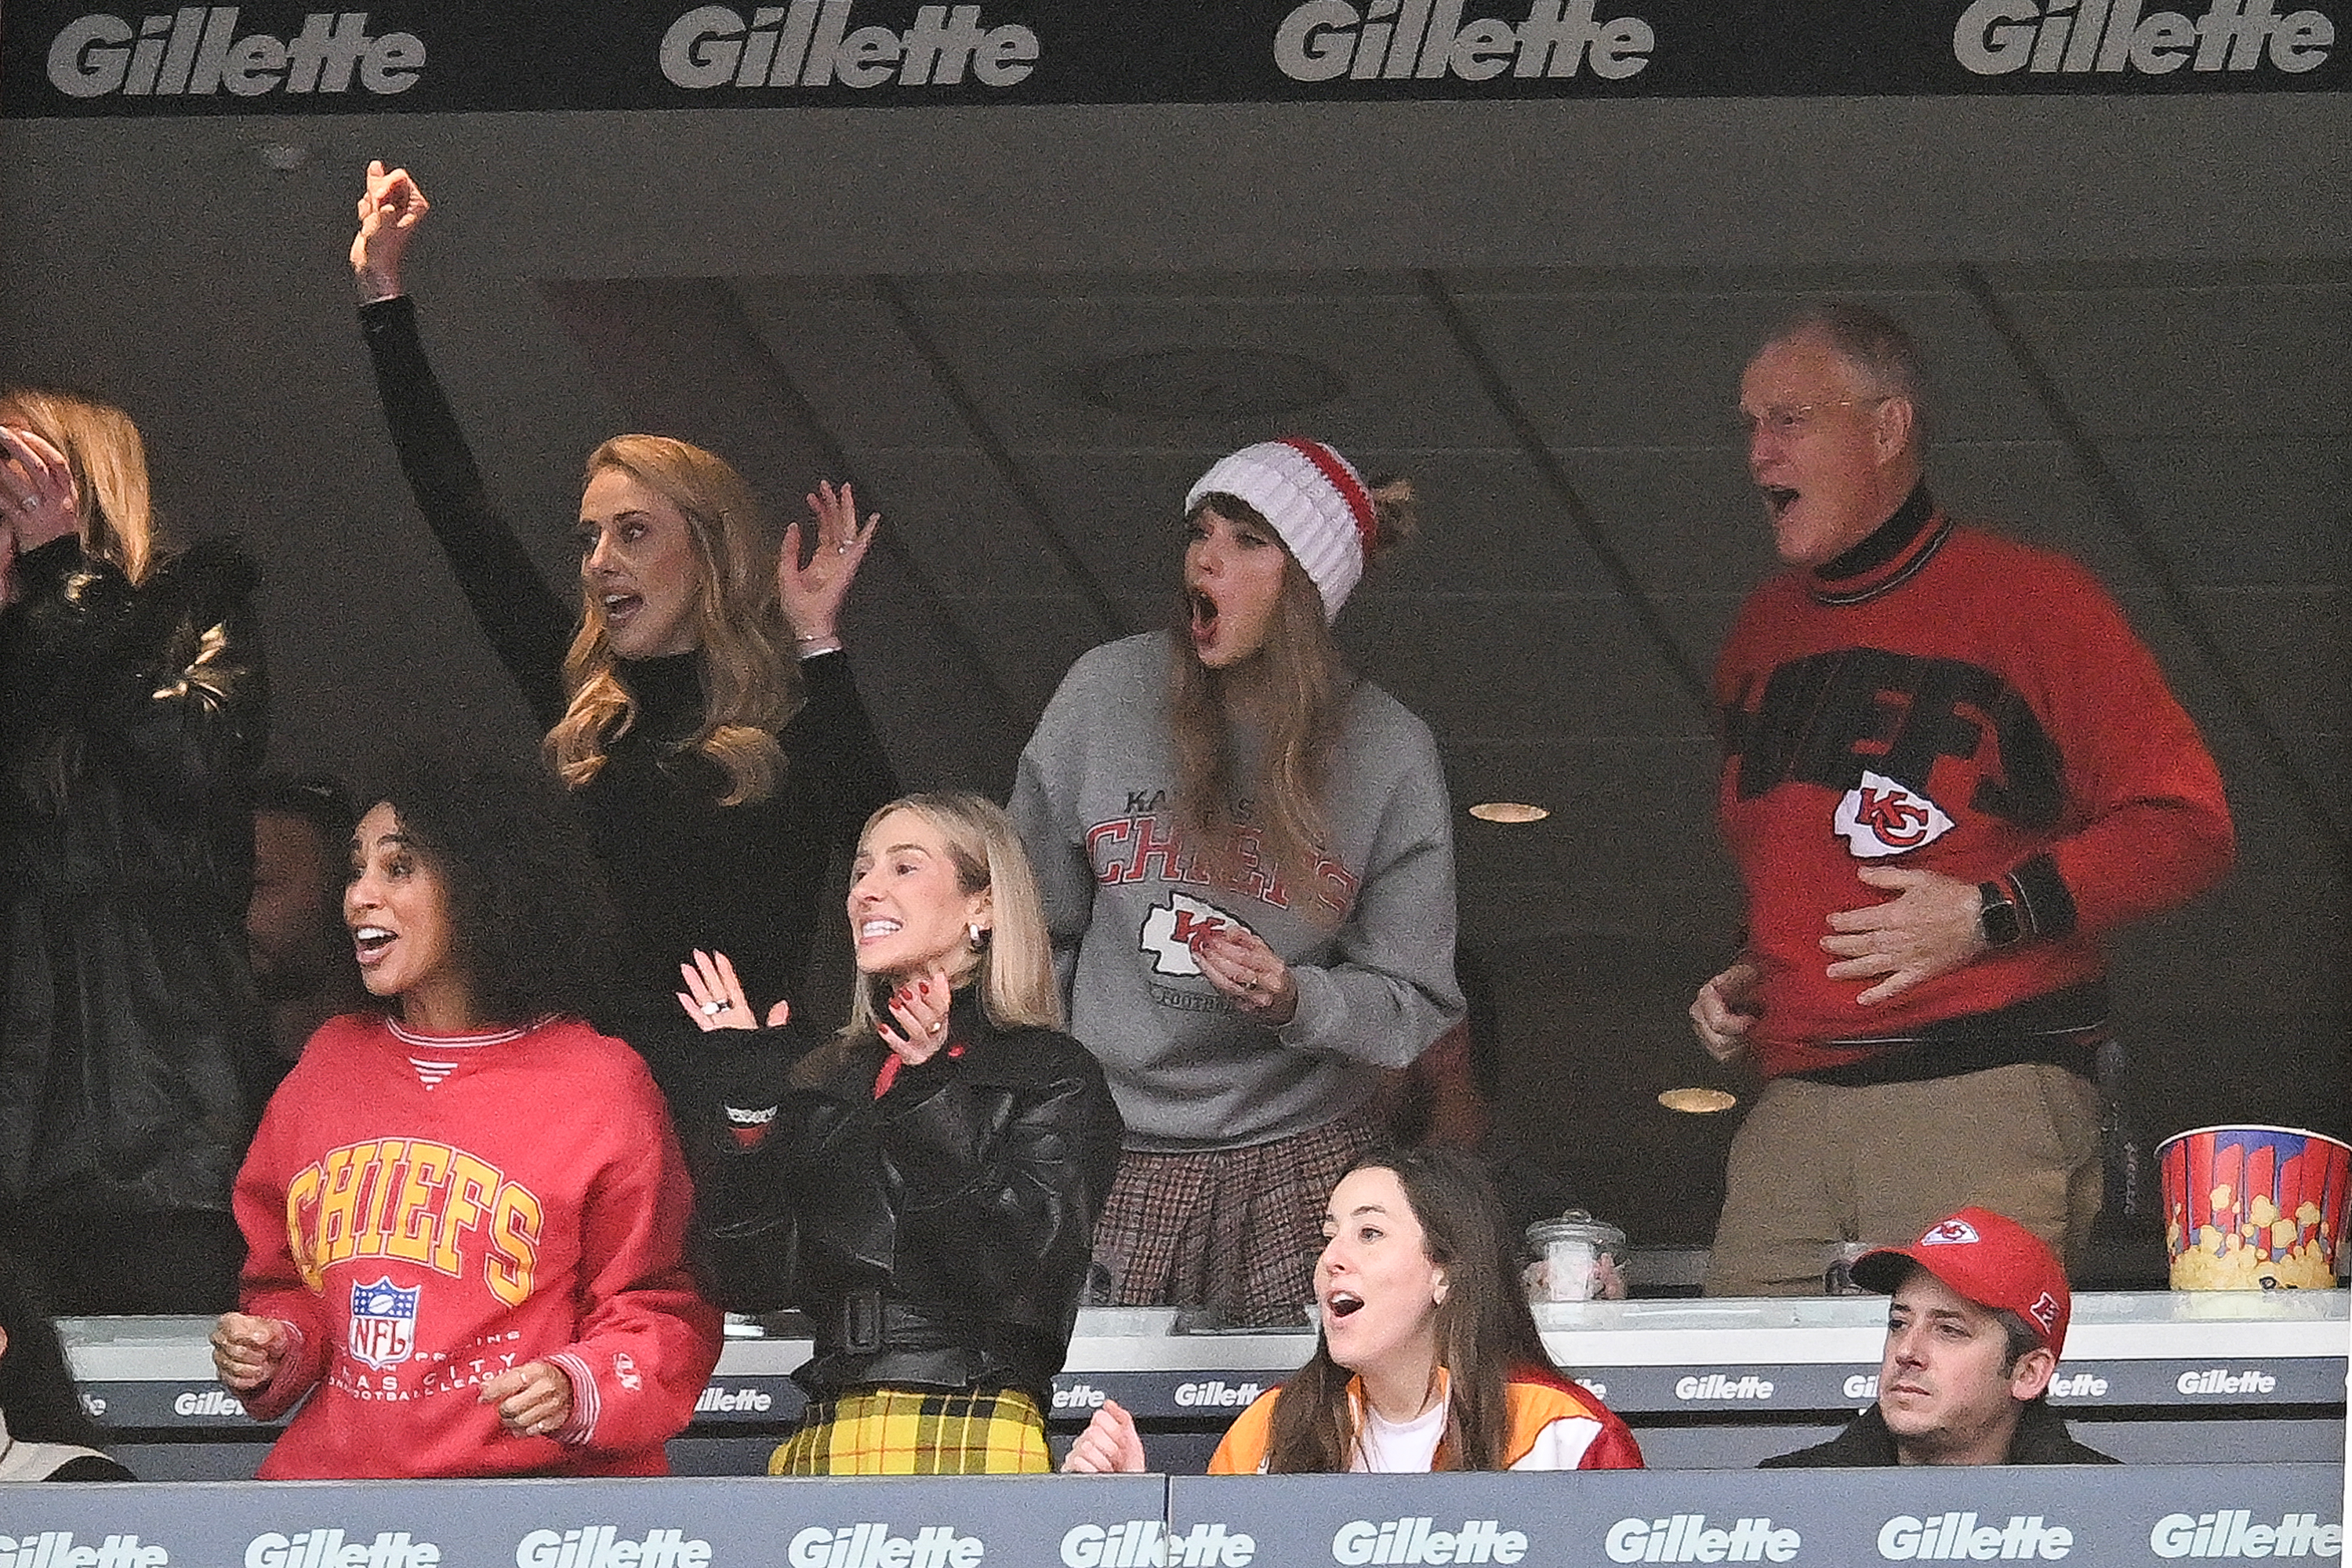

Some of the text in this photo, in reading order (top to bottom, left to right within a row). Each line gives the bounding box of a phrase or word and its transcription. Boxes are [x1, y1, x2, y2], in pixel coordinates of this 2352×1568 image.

[46, 6, 426, 97] Gillette
[659, 0, 1040, 89] Gillette
[1273, 0, 1655, 81] Gillette
[1953, 0, 2336, 74] Gillette
[1854, 787, 1929, 848] KC
[286, 1136, 546, 1308] CHIEFS
[353, 1317, 411, 1358] NFL
[423, 1352, 516, 1385] CITY
[1675, 1374, 1774, 1400] Gillette
[2047, 1372, 2109, 1398] lette
[2176, 1369, 2276, 1395] Gillette
[174, 1391, 246, 1416] Gille
[695, 1387, 772, 1412] illette
[1051, 1383, 1105, 1408] ette
[243, 1529, 441, 1568] Gillette
[516, 1526, 712, 1568] Gillette
[786, 1523, 984, 1568] Gillette
[1059, 1520, 1257, 1568] Gillette
[1332, 1517, 1528, 1565] Gillette
[1605, 1514, 1801, 1563] Gillette
[1877, 1512, 2074, 1560] Gillette
[2150, 1509, 2342, 1559] Gillette
